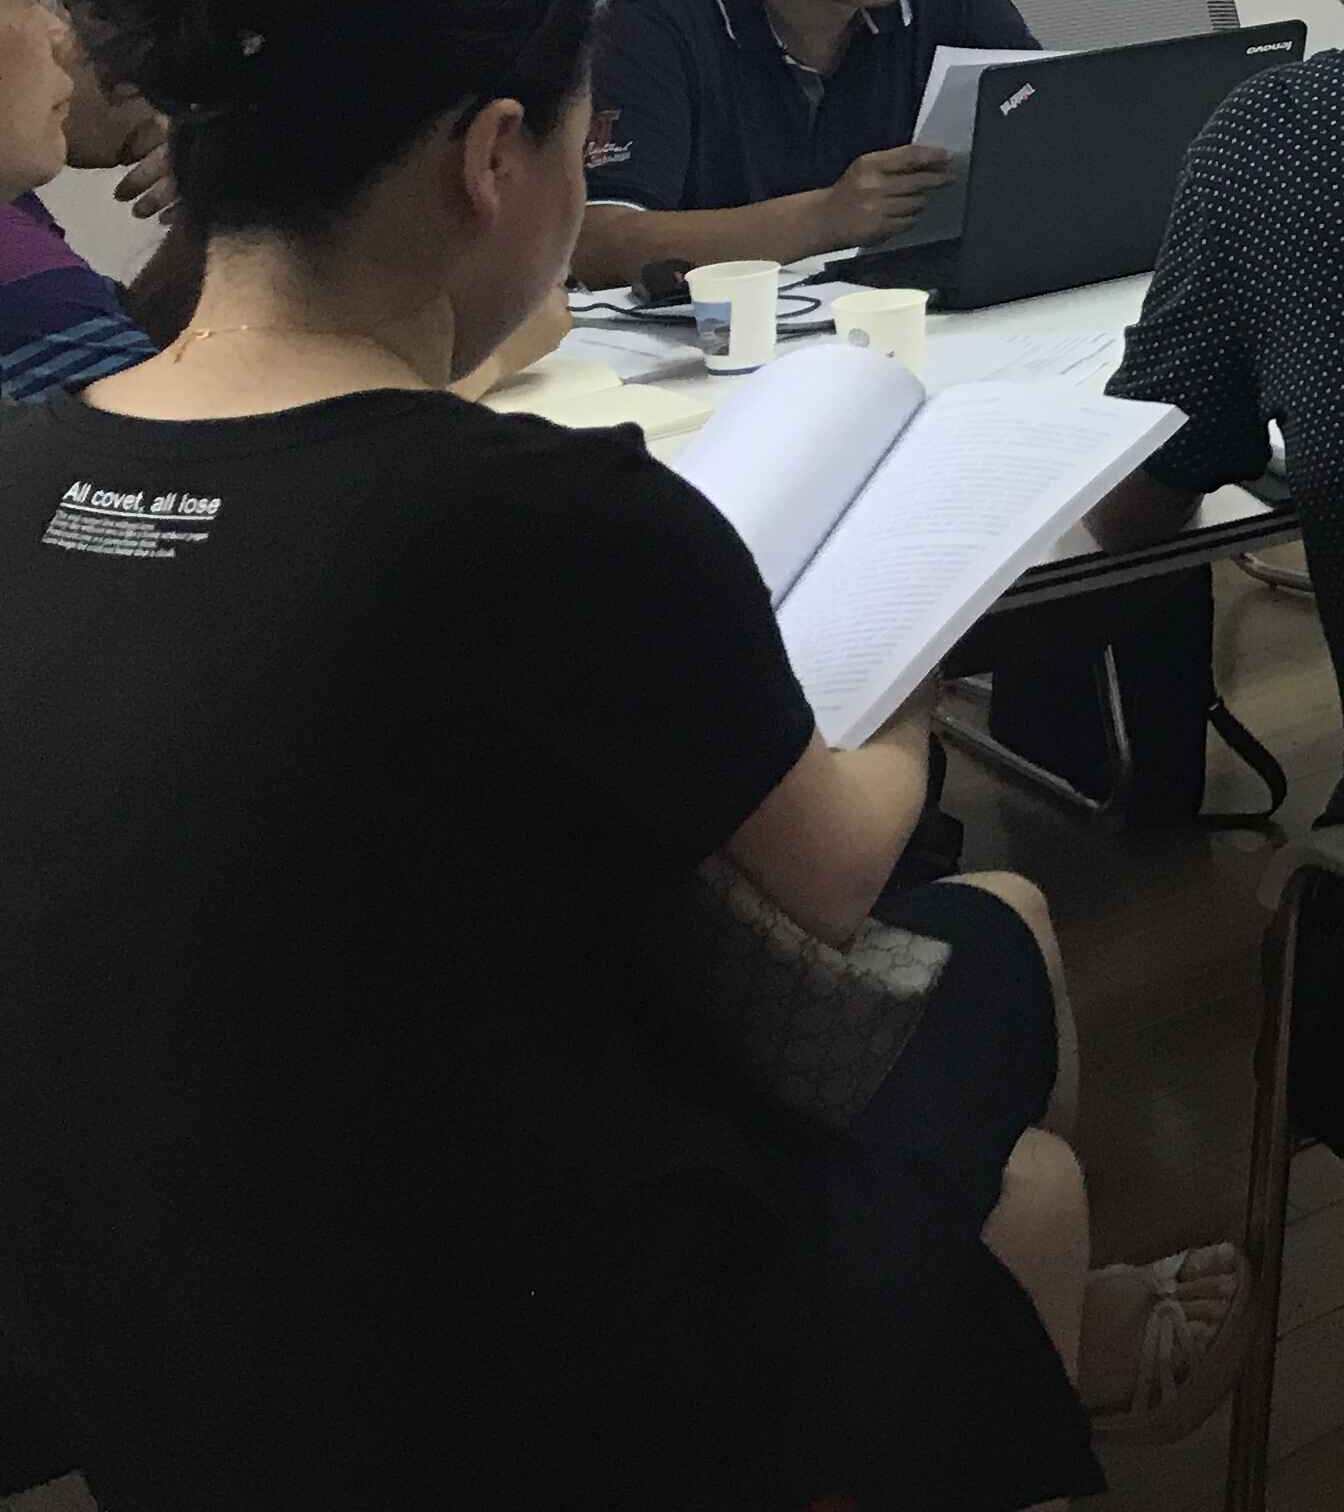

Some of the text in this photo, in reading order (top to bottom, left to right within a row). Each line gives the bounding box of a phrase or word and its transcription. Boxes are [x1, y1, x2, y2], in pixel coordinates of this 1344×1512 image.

[63, 481, 92, 503] All
[150, 492, 177, 513] all
[178, 492, 222, 515] lose
